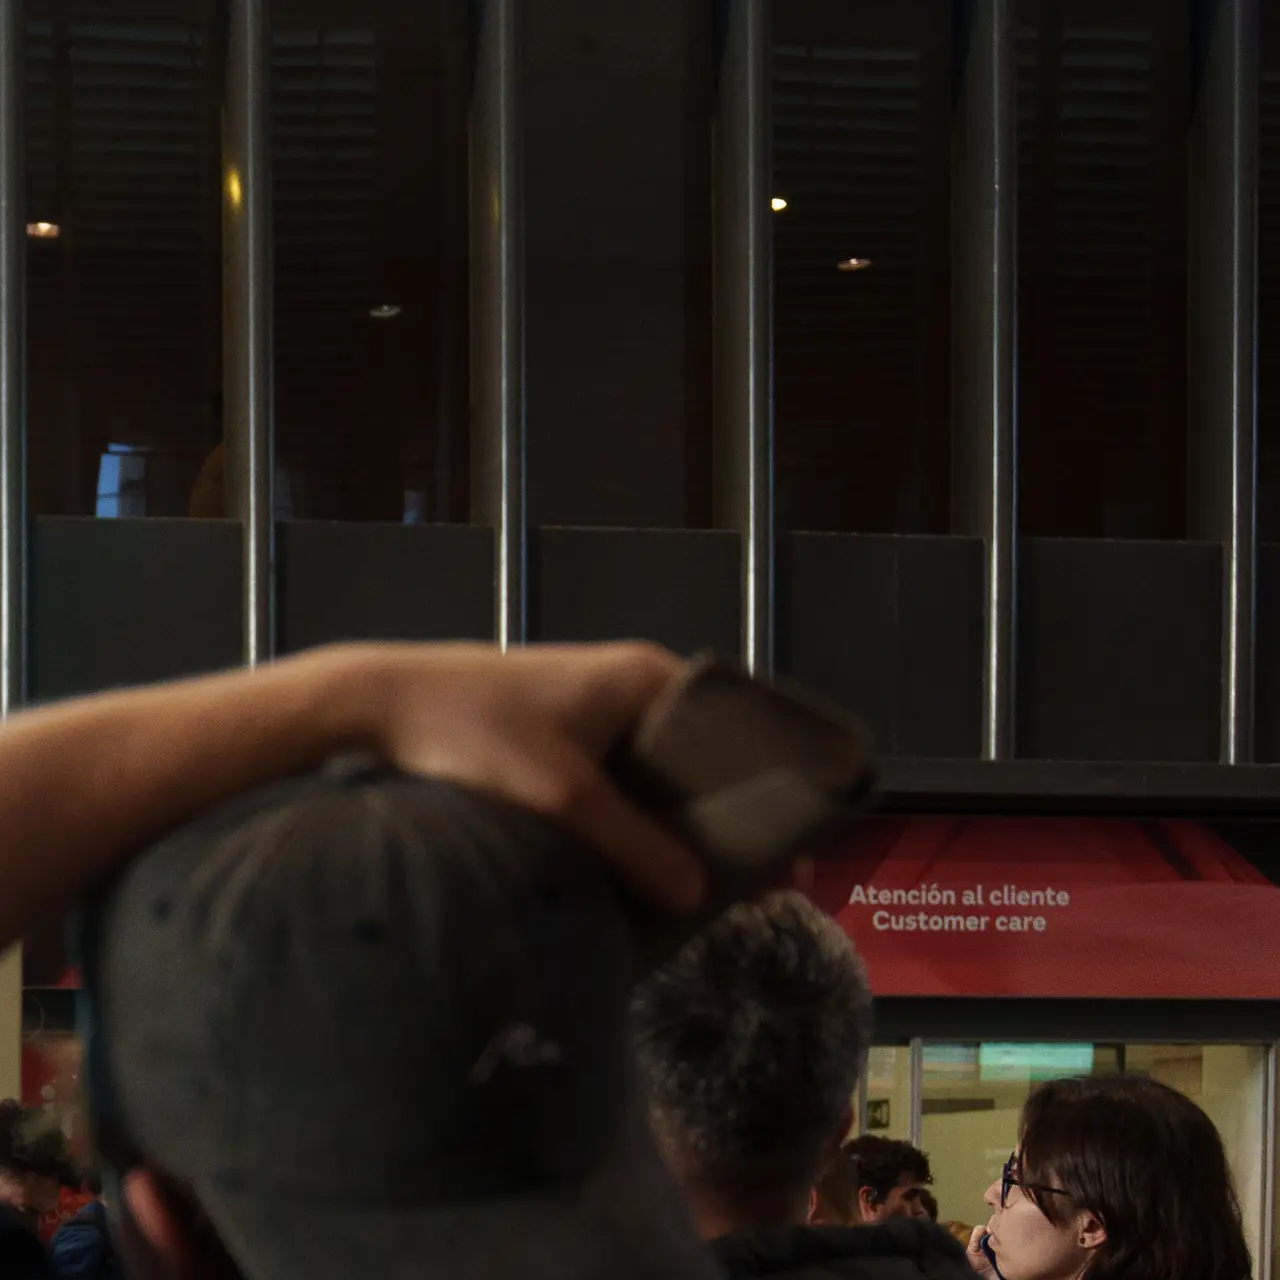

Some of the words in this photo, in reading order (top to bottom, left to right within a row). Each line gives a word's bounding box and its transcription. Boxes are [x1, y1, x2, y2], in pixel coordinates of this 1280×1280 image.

[849, 883, 956, 905] Atención
[962, 885, 984, 905] al
[989, 885, 1069, 906] cliente
[873, 911, 989, 931] Customer
[995, 916, 1046, 932] care
